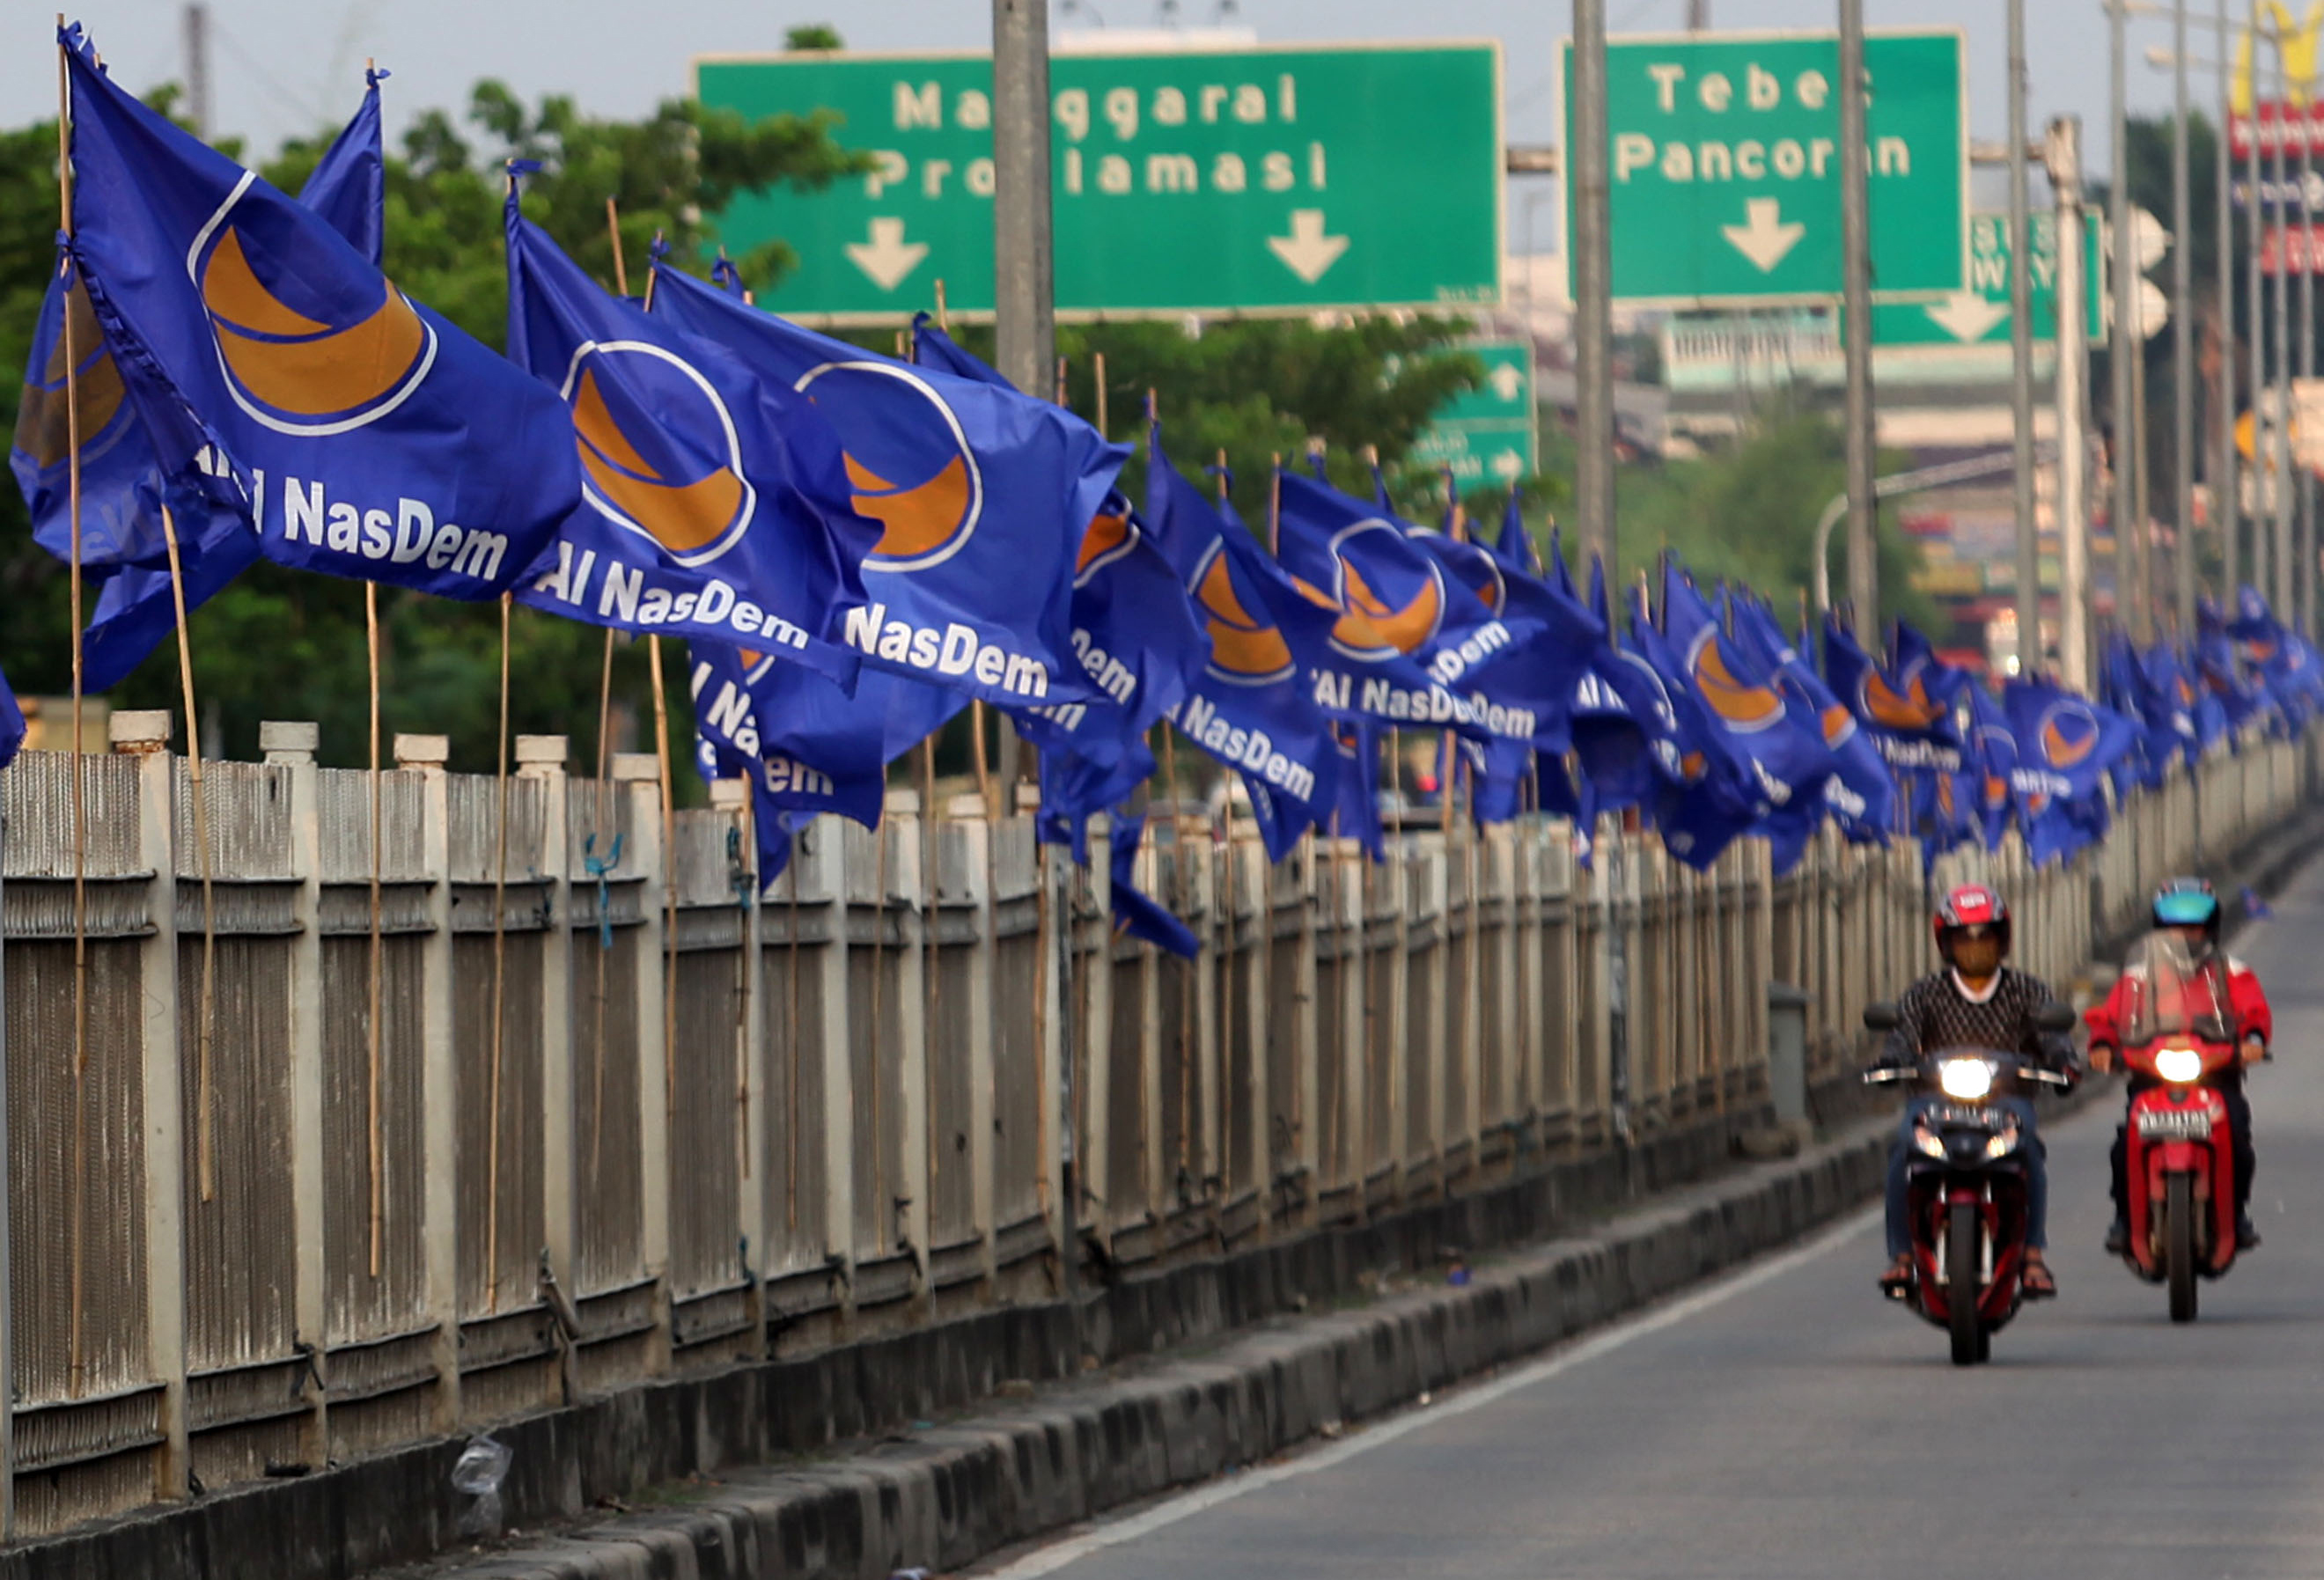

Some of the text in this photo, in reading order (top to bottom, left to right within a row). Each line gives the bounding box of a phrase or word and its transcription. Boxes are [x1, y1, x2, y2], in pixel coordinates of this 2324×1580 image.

[894, 73, 1296, 142] Maggarai
[1648, 62, 1872, 113] Tebe
[865, 140, 1327, 200] Prolamasi
[1614, 132, 1909, 184] Pancorn
[1973, 253, 2056, 290] WY
[284, 476, 508, 581] NasDem
[598, 560, 809, 650] NasDem
[845, 603, 1048, 697] NasDem
[1183, 693, 1315, 803] NasDem
